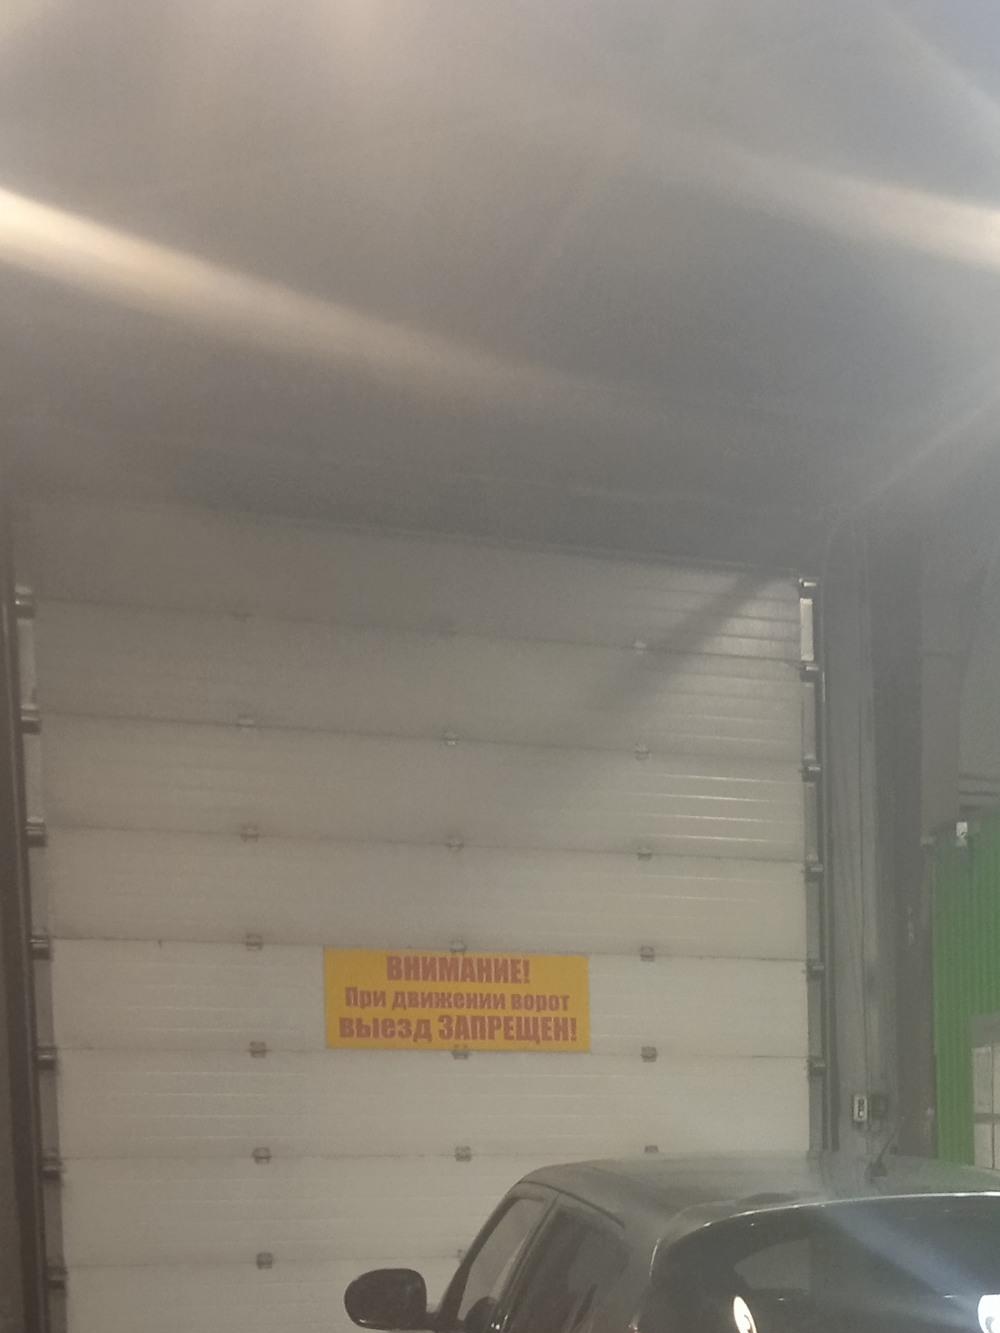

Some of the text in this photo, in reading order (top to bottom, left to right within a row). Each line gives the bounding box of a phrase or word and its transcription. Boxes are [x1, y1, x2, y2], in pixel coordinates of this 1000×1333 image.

[386, 955, 530, 984] ВНИМАНИЕ!
[345, 986, 570, 1012] При движении ворот
[438, 1014, 577, 1044] ЗАПРЕЩЕН!
